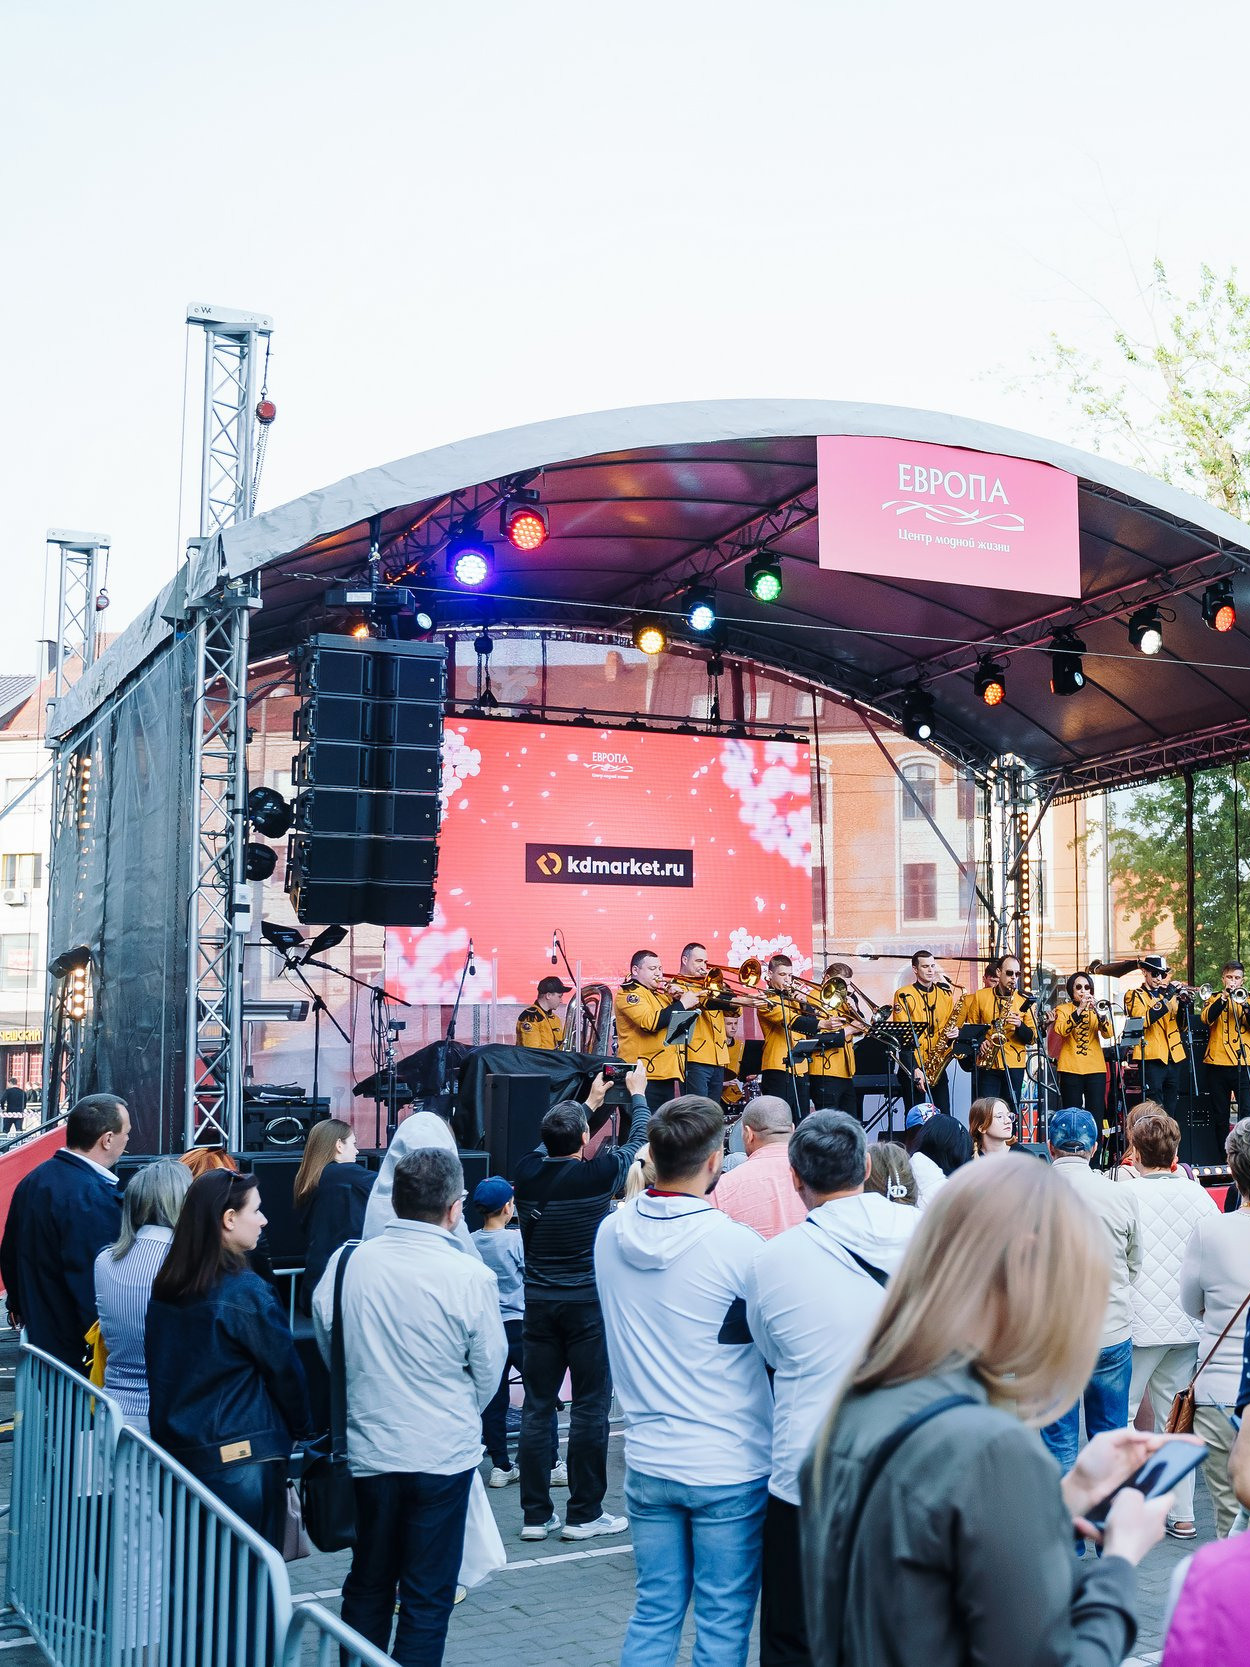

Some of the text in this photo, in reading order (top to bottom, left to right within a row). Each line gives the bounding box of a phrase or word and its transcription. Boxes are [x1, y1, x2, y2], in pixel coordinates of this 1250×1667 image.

[898, 463, 1010, 505] ЕВРОПА
[898, 528, 1010, 553] Центр модной жизни
[592, 751, 629, 764] ЕВРОПА
[567, 855, 685, 876] kdmarket.ru
